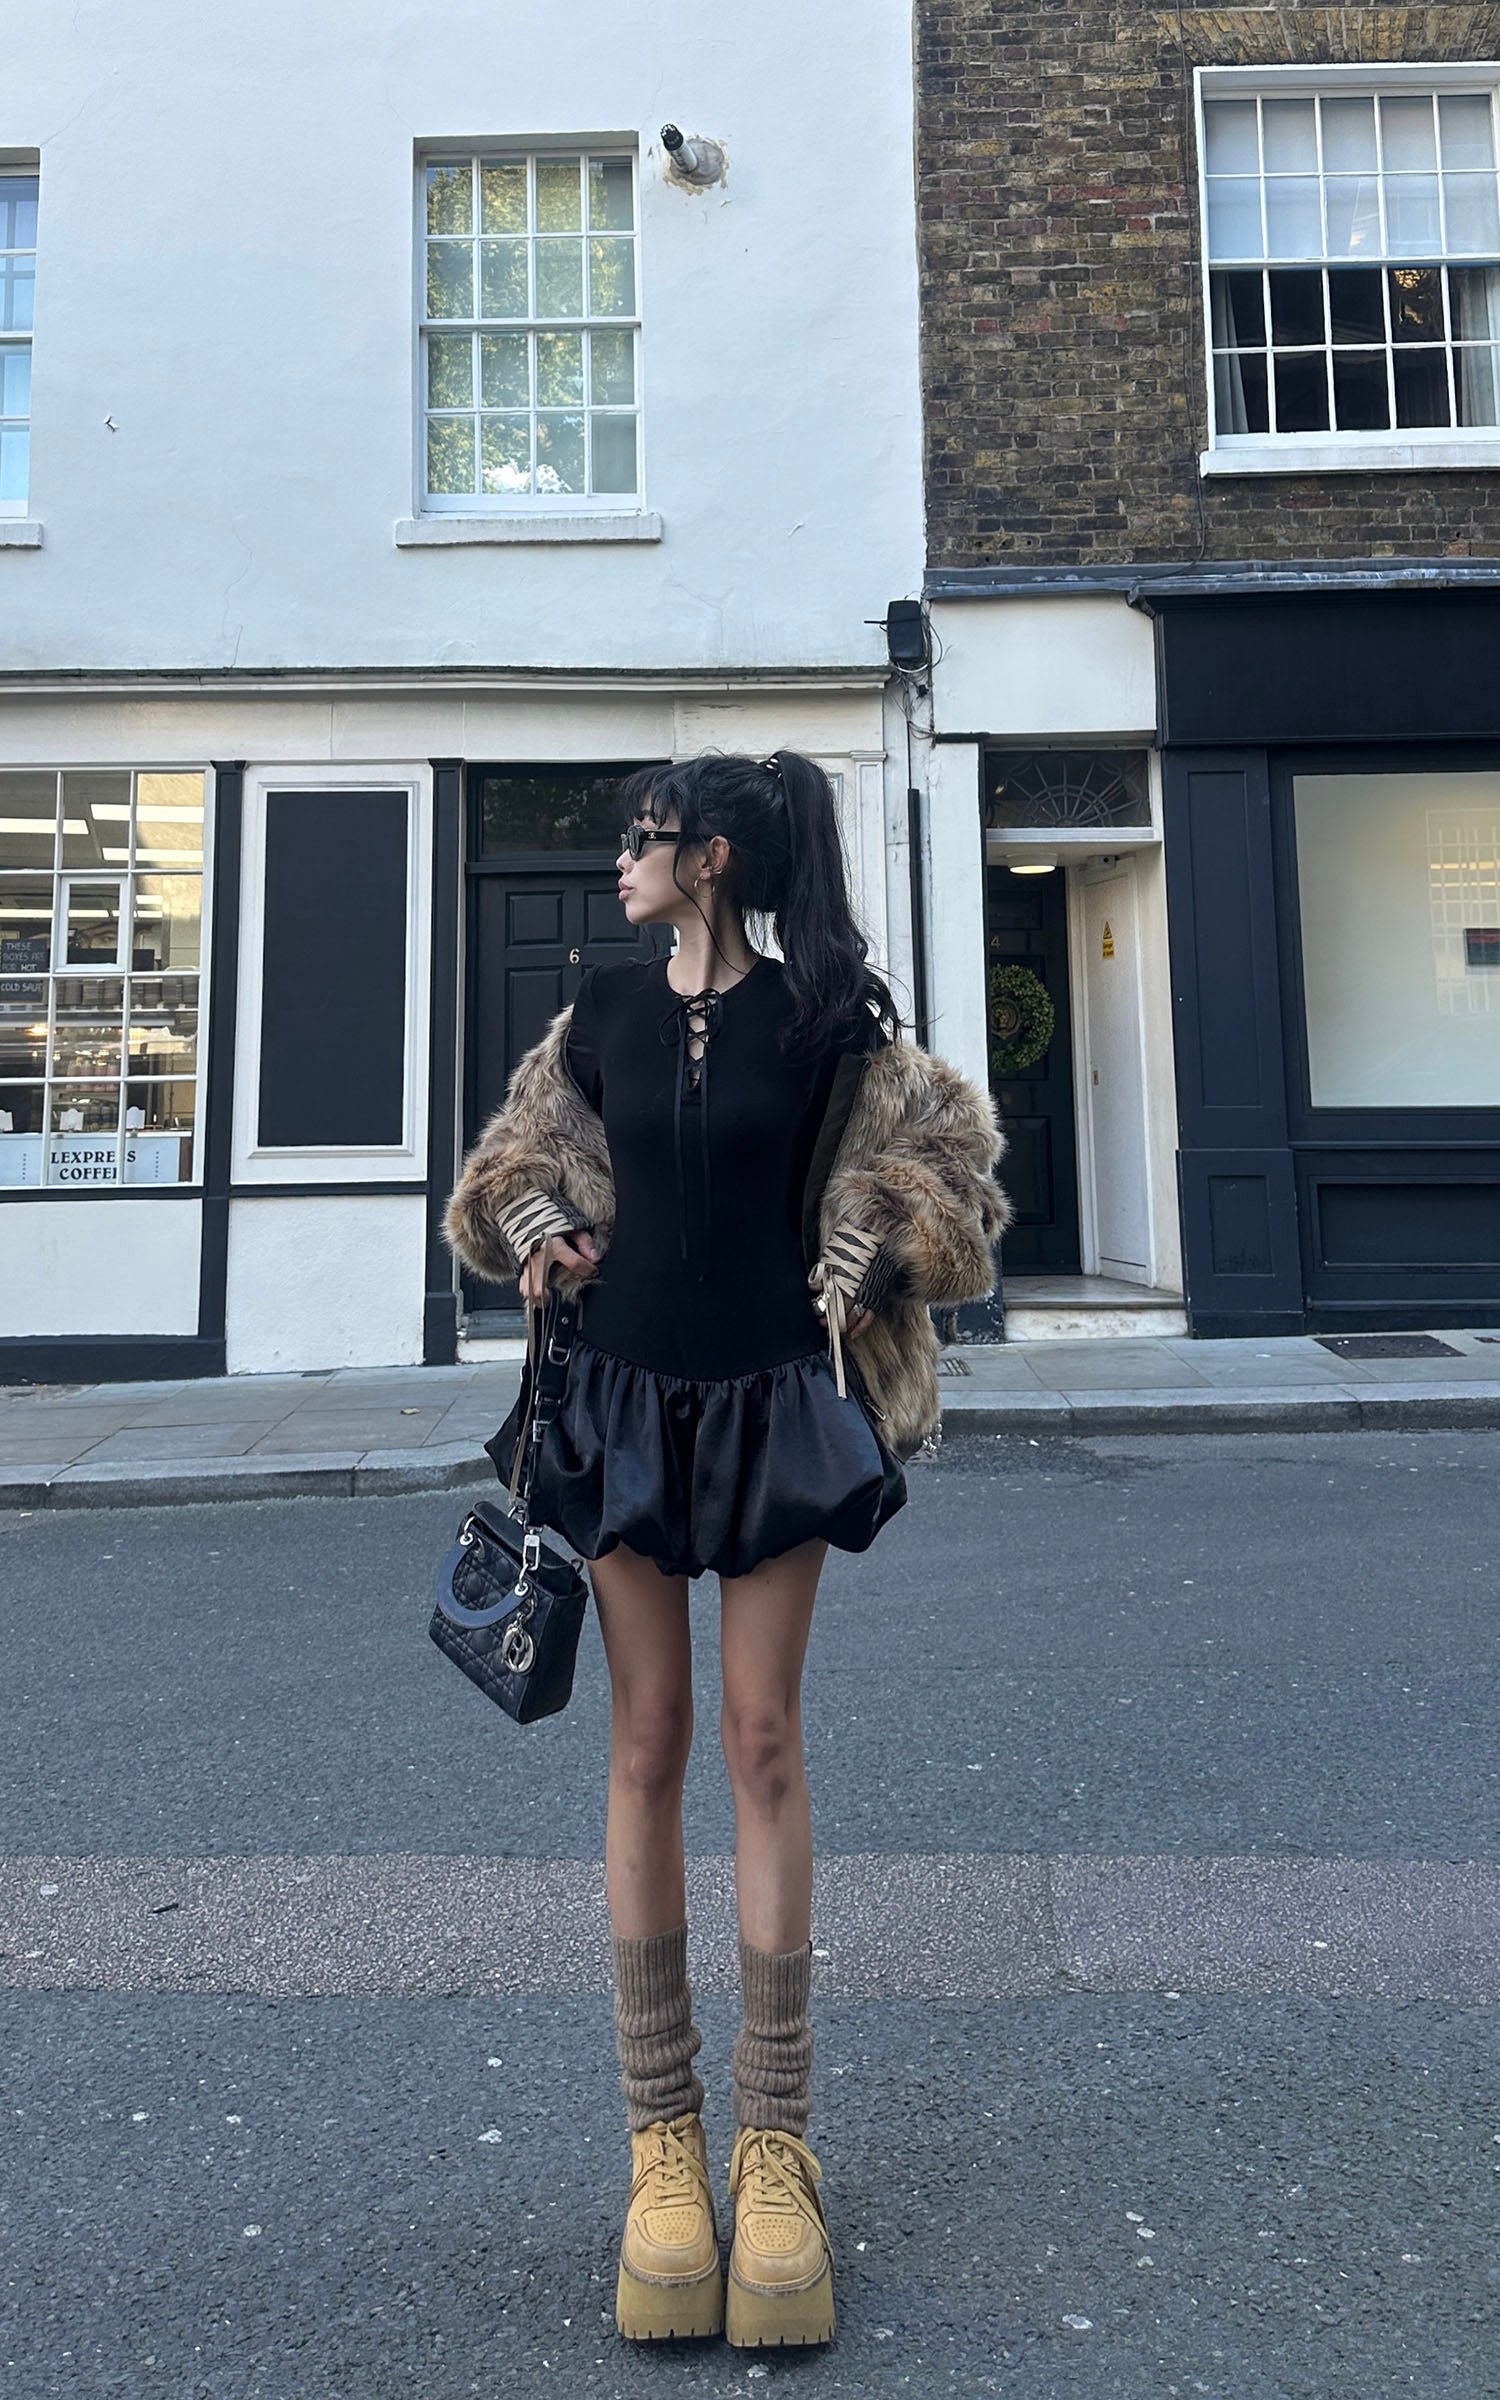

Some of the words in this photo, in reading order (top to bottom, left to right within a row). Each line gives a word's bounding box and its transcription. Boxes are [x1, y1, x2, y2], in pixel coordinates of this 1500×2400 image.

[5, 942, 31, 951] THESE
[990, 935, 1001, 950] 4
[569, 948, 580, 964] 6
[20, 963, 38, 972] HOT
[0, 982, 21, 992] COLD
[51, 1150, 136, 1164] LEXPRES
